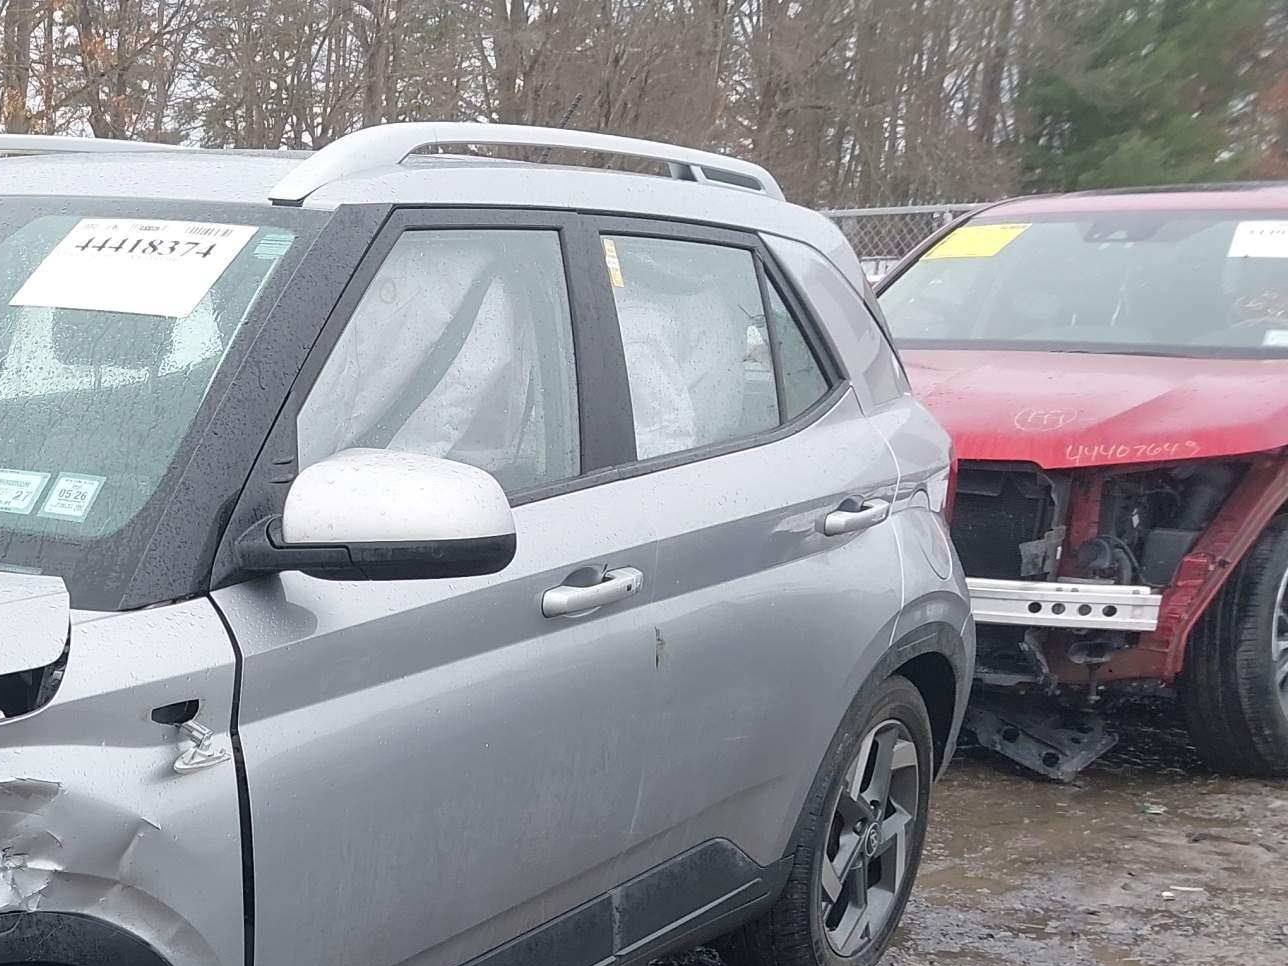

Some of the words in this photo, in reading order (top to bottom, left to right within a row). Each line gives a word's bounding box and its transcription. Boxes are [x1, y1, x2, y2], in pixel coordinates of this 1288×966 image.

[75, 237, 216, 258] 44418374
[1065, 440, 1201, 466] 44407649
[13, 490, 33, 502] 27
[73, 490, 89, 501] 26
